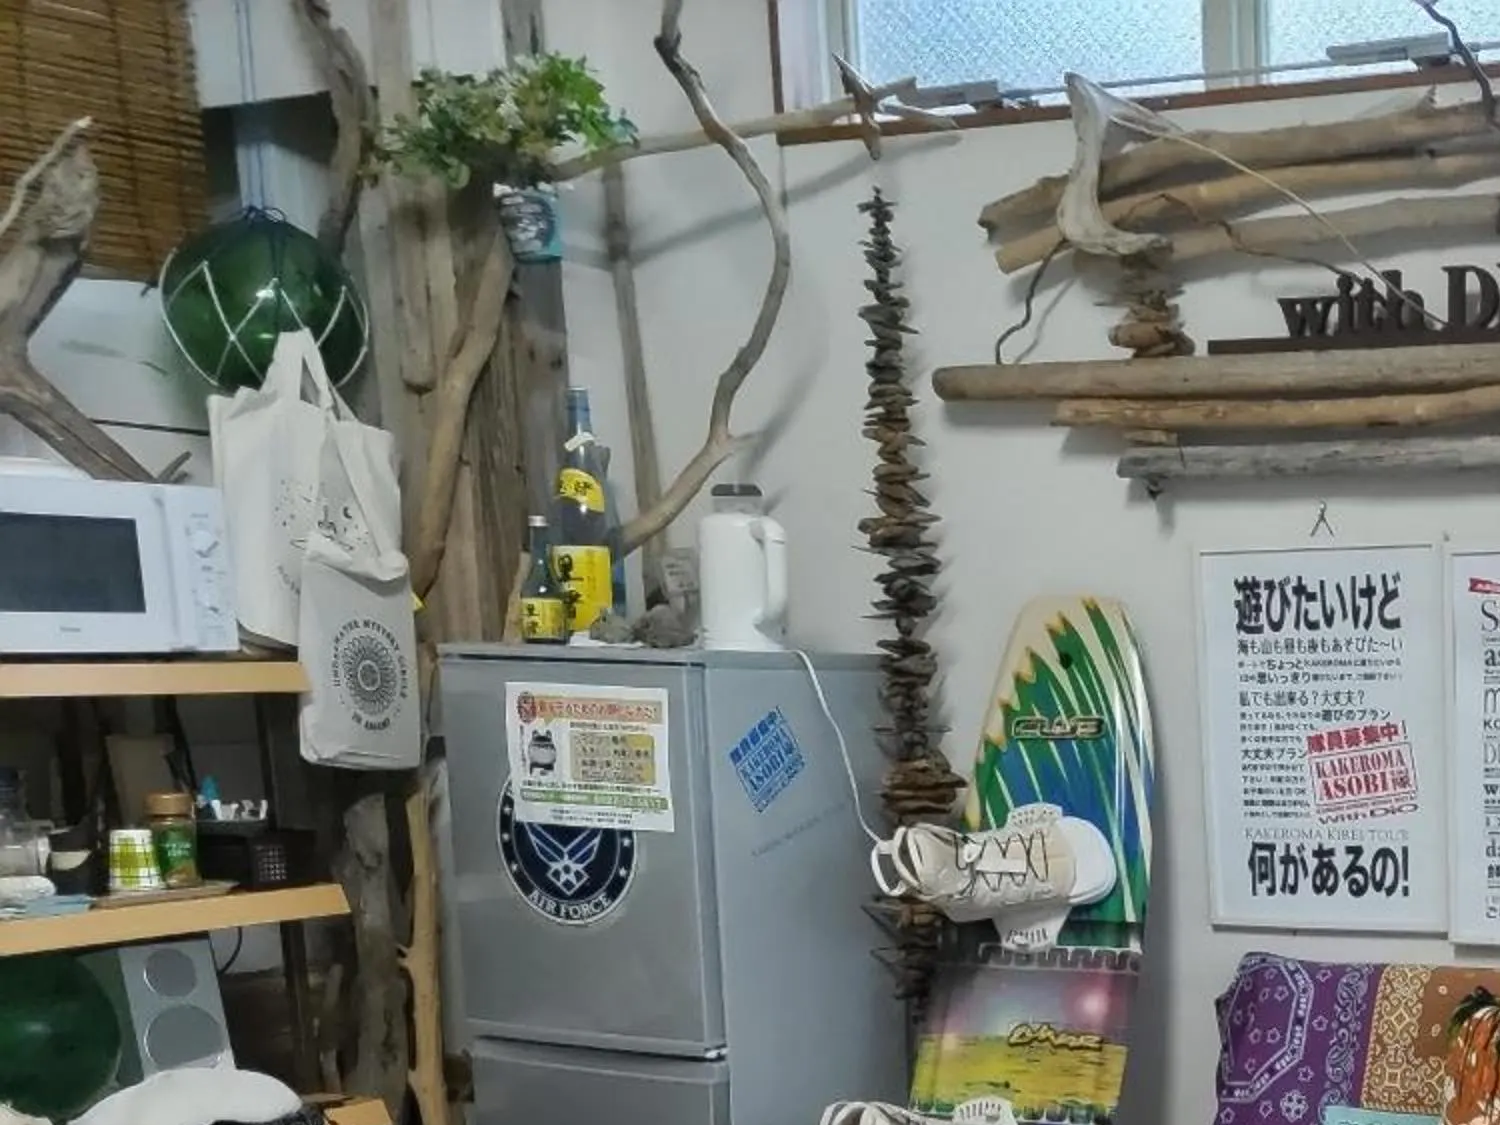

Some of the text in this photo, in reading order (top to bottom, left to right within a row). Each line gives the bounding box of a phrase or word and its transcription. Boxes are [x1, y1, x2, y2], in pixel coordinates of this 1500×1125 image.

[1277, 269, 1426, 338] with
[1234, 572, 1402, 634] 遊びたいけど
[1316, 749, 1406, 779] KAKEROMA
[1318, 772, 1388, 801] ASOBI
[1248, 841, 1409, 898] 何があるの!
[528, 889, 612, 918] AIR FORCE
